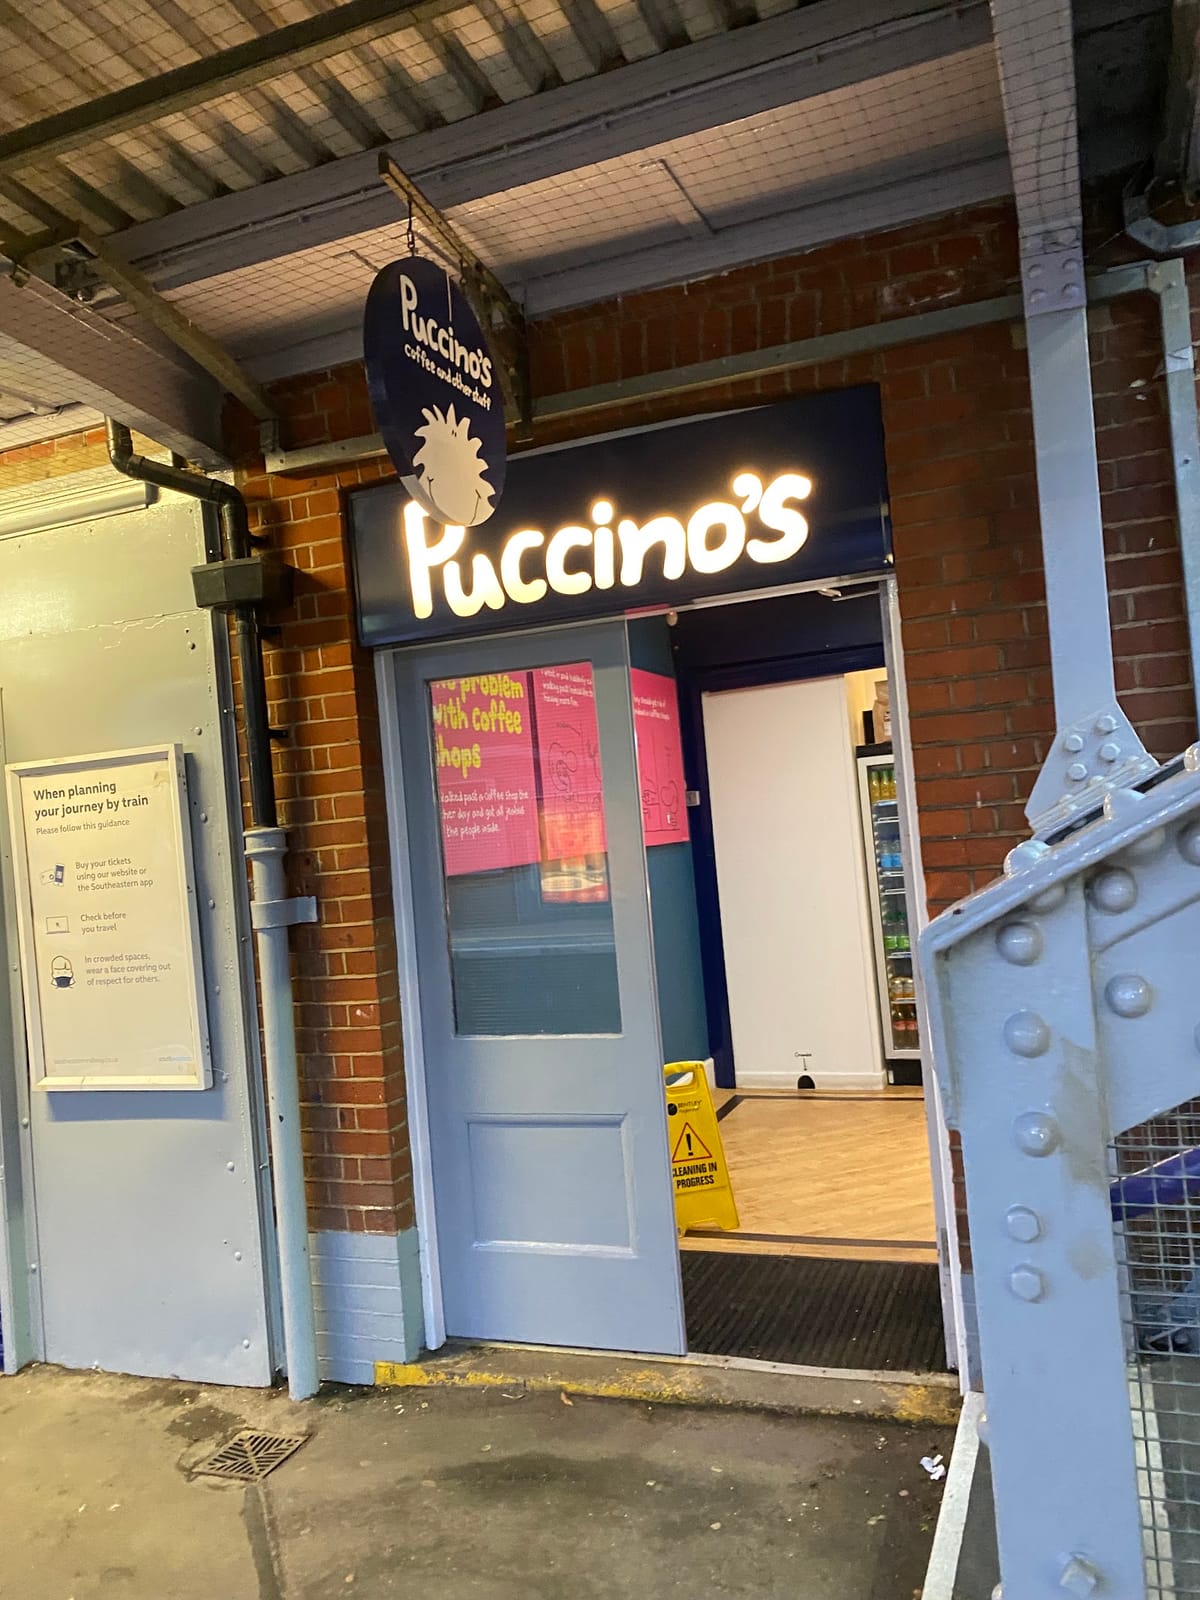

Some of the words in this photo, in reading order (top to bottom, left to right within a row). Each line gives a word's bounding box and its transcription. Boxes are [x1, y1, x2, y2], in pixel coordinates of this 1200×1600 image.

[400, 274, 493, 388] Puccino's
[404, 343, 436, 374] coffee
[436, 367, 452, 383] and
[451, 372, 472, 397] other
[472, 386, 491, 411] stuff
[403, 473, 812, 619] Puccino's
[460, 674, 524, 703] problem
[437, 734, 481, 779] hops
[33, 788, 65, 800] When
[68, 782, 117, 798] planning
[35, 808, 59, 820] your
[61, 801, 104, 817] journey
[106, 798, 120, 811] by
[122, 795, 148, 808] train
[36, 826, 58, 835] Please
[60, 824, 82, 833] follow
[83, 821, 97, 830] this
[98, 818, 130, 830] guidance
[76, 862, 89, 870] Buy
[90, 860, 106, 868] your
[108, 858, 132, 866] tickets
[76, 872, 96, 882] using
[110, 868, 138, 878] website
[78, 884, 90, 892] the
[91, 880, 138, 891] Southeastern
[140, 879, 153, 888] app
[80, 912, 102, 922] Check
[103, 912, 126, 921] before
[82, 927, 95, 936] you
[96, 923, 117, 932] travel
[84, 956, 92, 964] In
[93, 954, 124, 963] crowded
[110, 964, 126, 973] face
[126, 962, 158, 973] covering
[87, 977, 94, 986] of
[96, 977, 122, 986] respect
[123, 976, 134, 984] for
[708, 1162, 718, 1172] IN
[676, 1175, 714, 1189] PROGRESS
